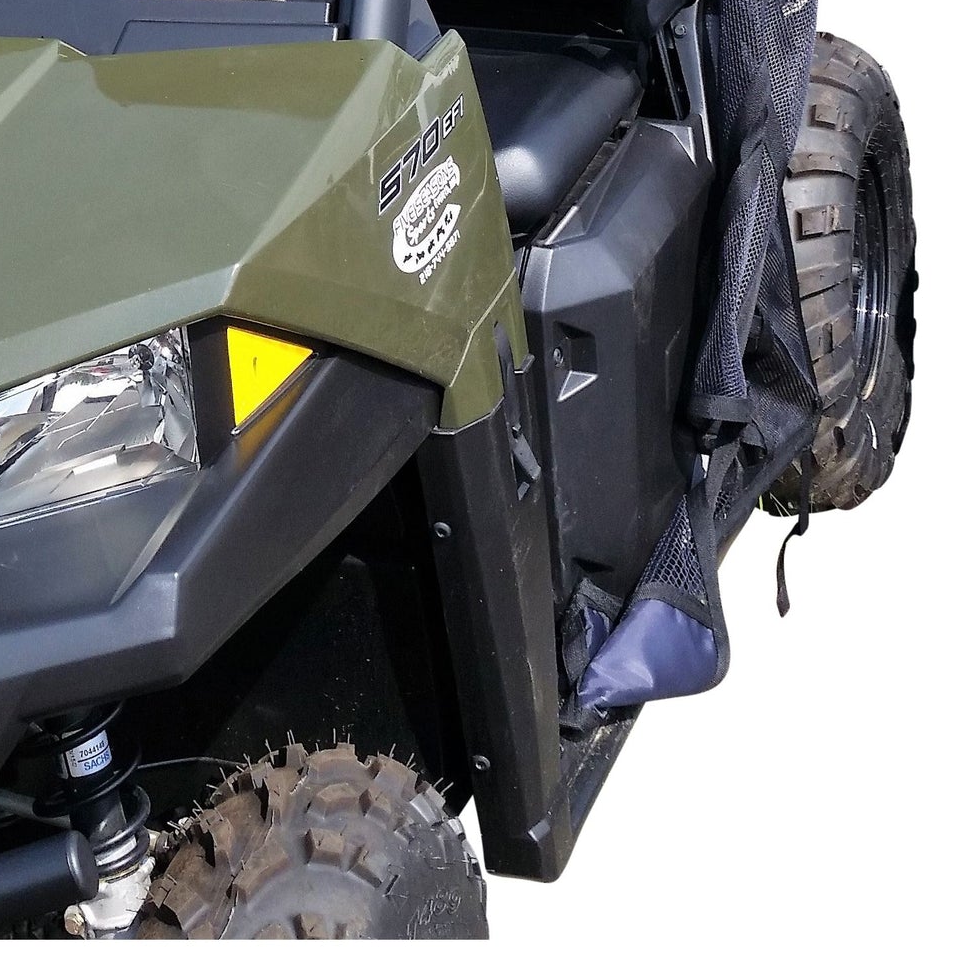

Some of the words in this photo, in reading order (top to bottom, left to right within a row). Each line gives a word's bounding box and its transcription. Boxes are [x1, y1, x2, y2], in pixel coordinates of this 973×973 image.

[378, 115, 442, 216] 570
[442, 91, 464, 140] EFI
[406, 205, 436, 246] Sports
[83, 750, 110, 771] SACHS
